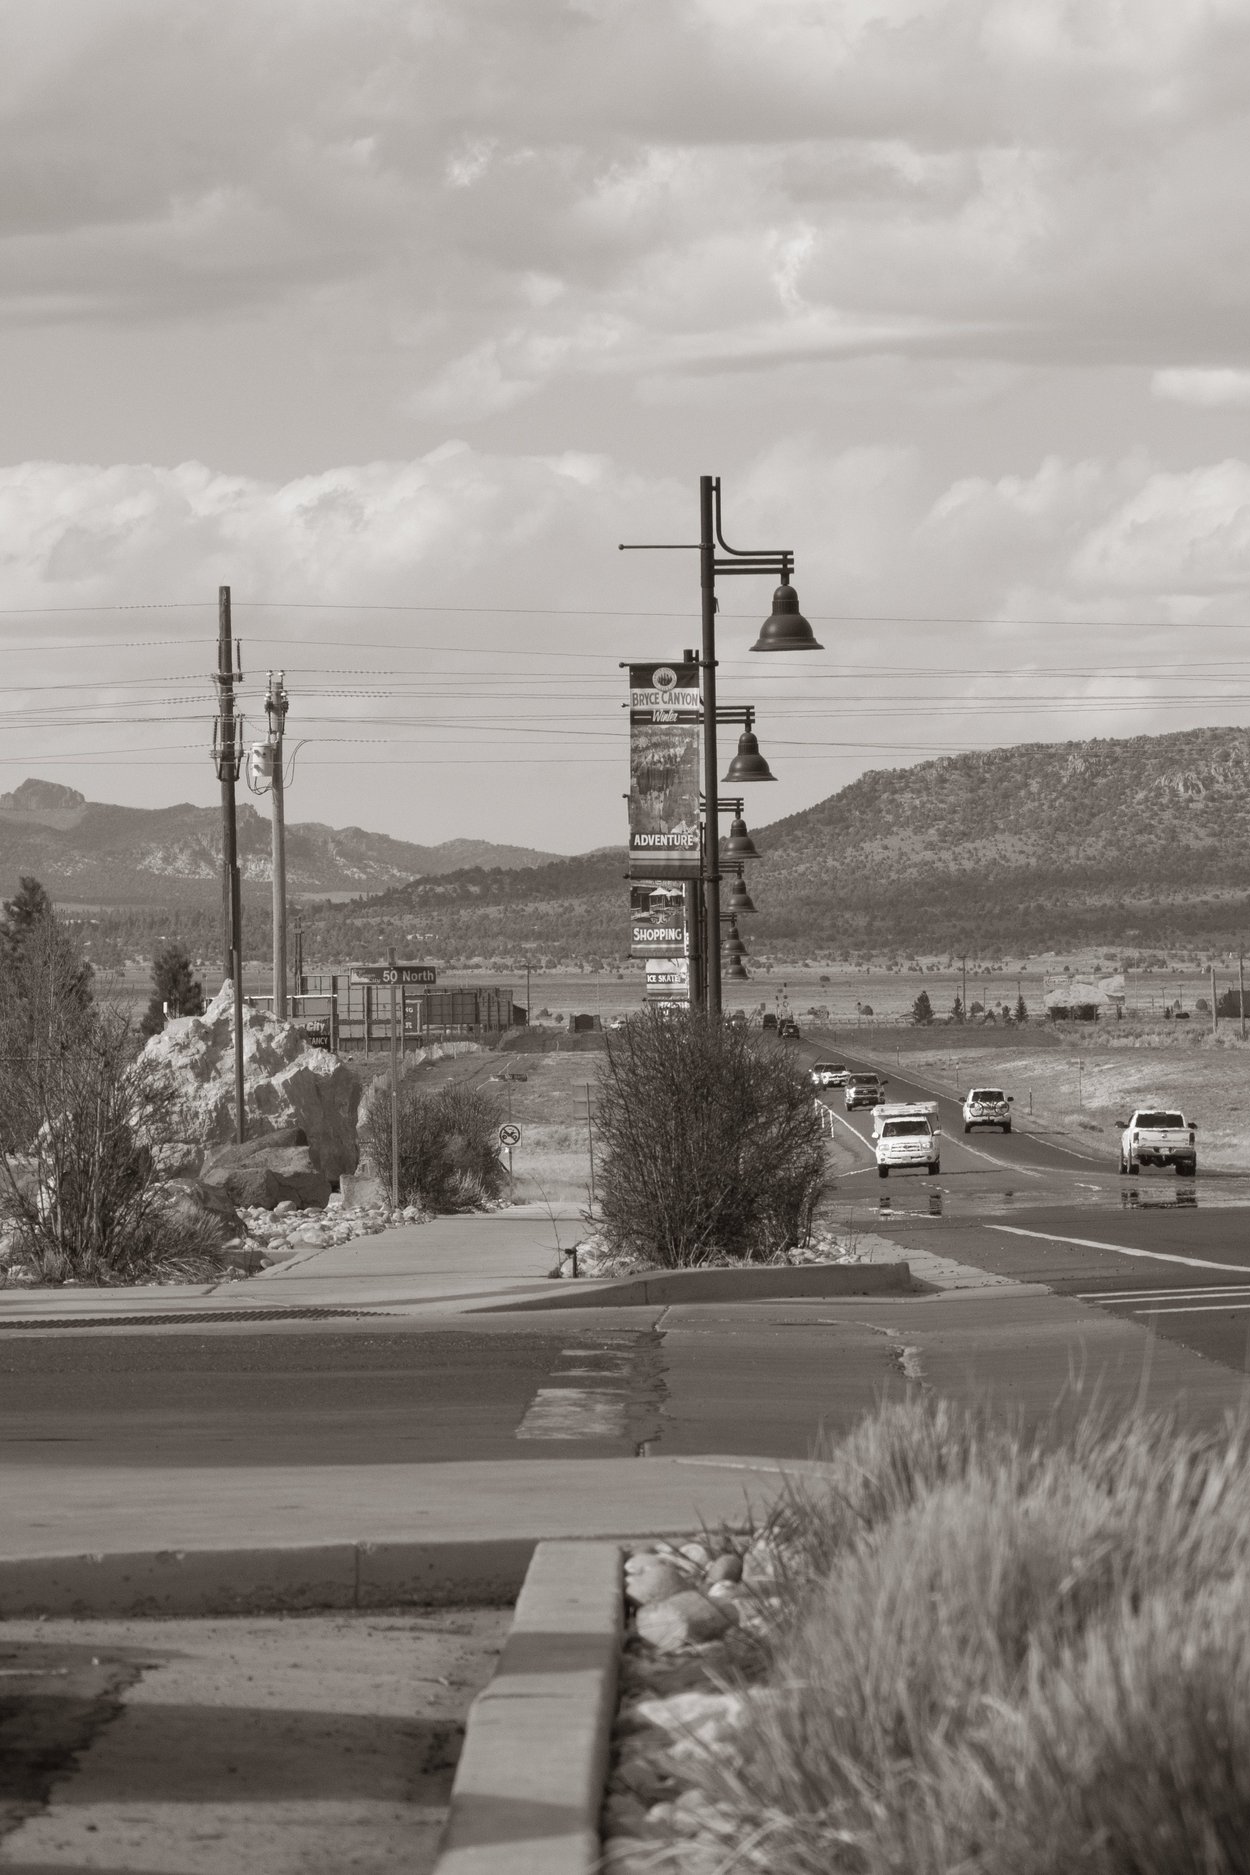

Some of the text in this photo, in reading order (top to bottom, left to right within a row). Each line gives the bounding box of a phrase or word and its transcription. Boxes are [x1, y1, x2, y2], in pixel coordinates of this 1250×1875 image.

[632, 691, 698, 707] BRYCE CANYON
[652, 709, 679, 722] Winter
[634, 834, 694, 846] ADVENTURE
[633, 927, 682, 941] SHOPPING
[382, 969, 434, 982] 50 North
[647, 974, 657, 983] ICE
[306, 1021, 325, 1033] City
[309, 1037, 328, 1045] ANCY
